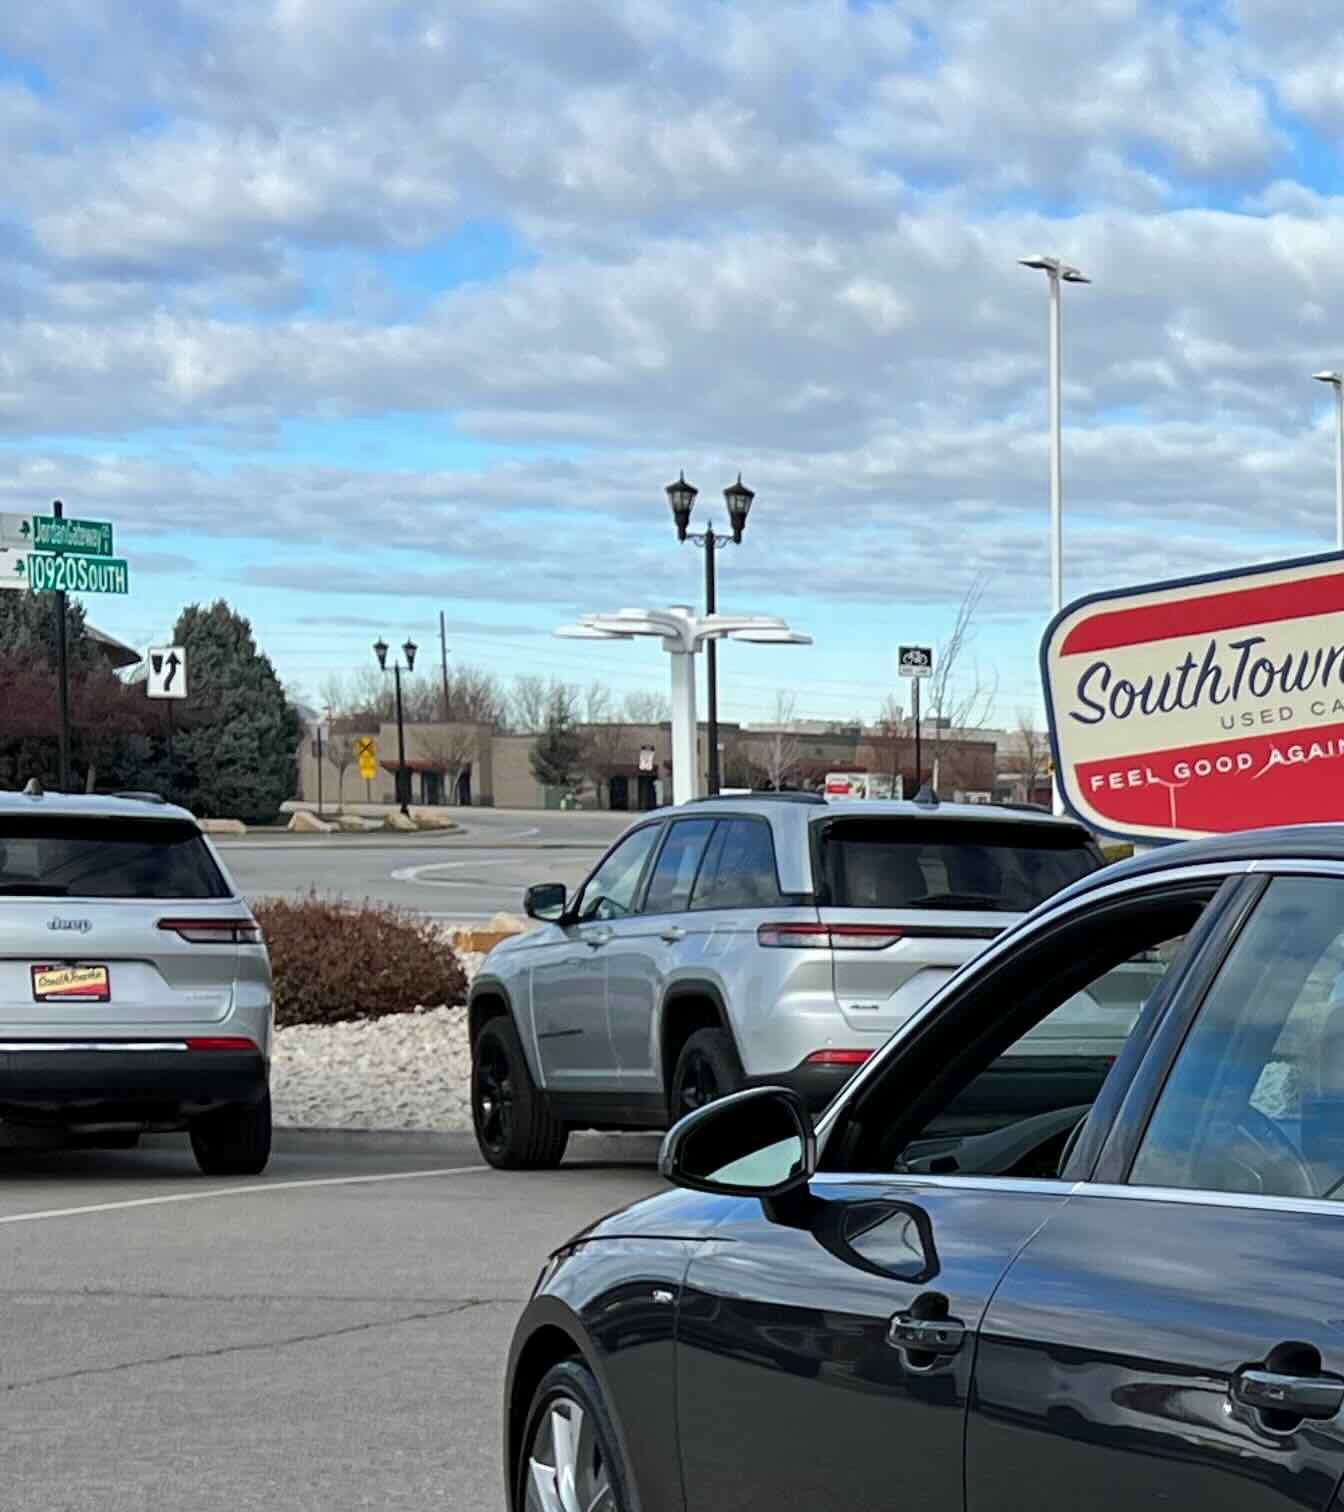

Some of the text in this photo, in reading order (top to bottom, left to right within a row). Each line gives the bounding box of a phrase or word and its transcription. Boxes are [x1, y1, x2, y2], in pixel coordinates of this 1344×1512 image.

[1220, 705, 1294, 731] USED
[1091, 768, 1161, 793] FEEL
[1174, 753, 1254, 780] GOOD
